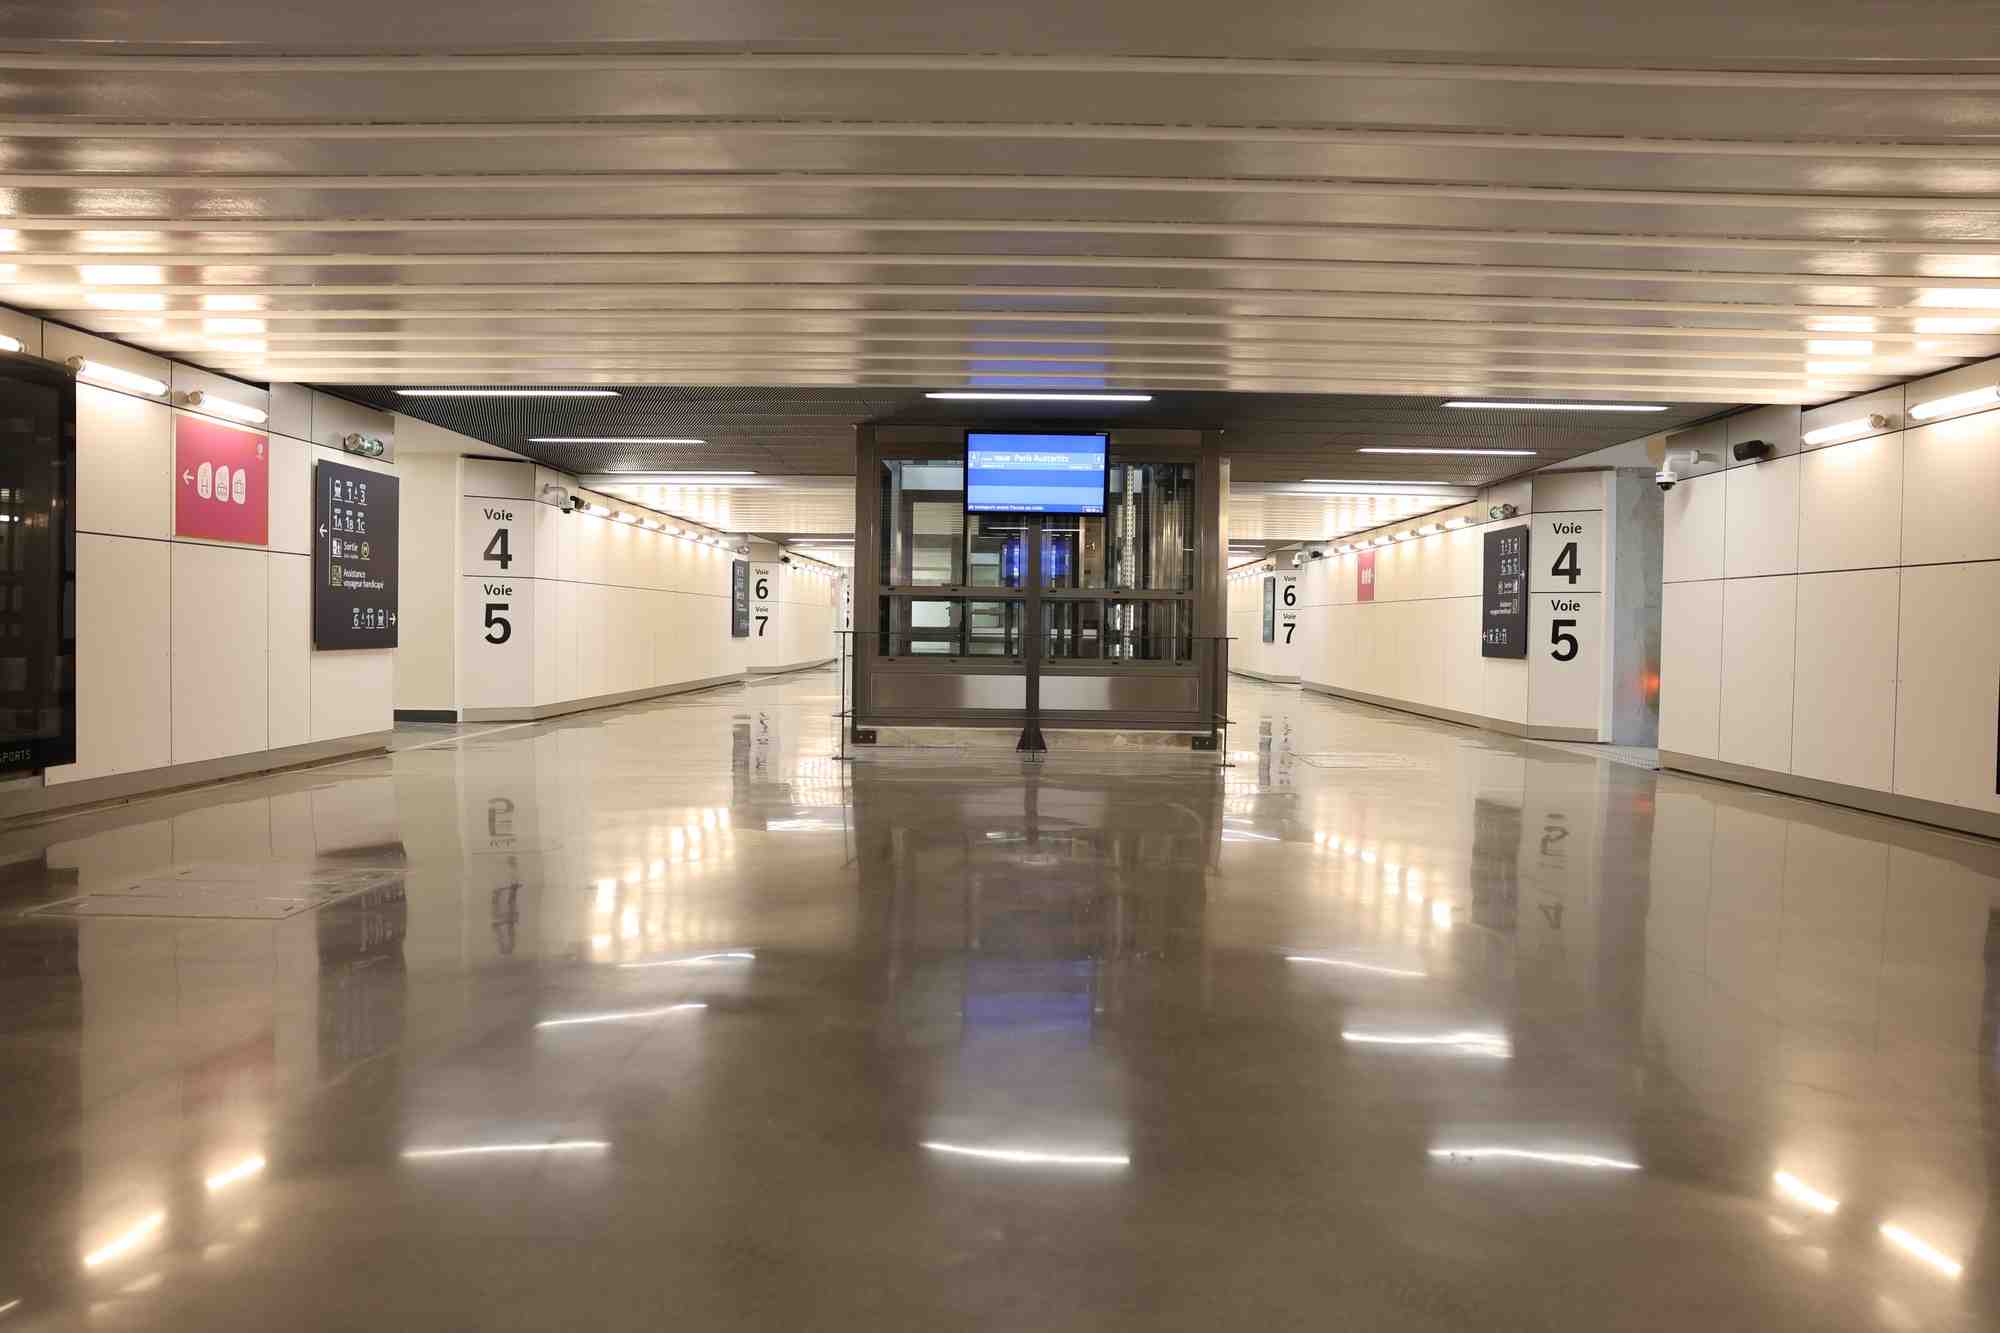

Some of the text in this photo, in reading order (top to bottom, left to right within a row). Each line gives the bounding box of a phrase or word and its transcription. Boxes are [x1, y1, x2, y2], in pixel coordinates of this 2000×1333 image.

[333, 515, 342, 529] 1A
[345, 516, 354, 530] 1B
[484, 508, 513, 521] Voie
[1553, 523, 1582, 534] Voie
[344, 541, 359, 551] Sortie
[483, 528, 512, 569] 4
[1551, 542, 1581, 584] 4
[484, 584, 513, 596] Voie
[755, 578, 768, 599] 6
[1284, 585, 1296, 606] 6
[1552, 600, 1580, 611] Voie
[485, 603, 511, 645] 5
[755, 616, 768, 636] 7
[1283, 623, 1296, 643] 7
[1551, 619, 1578, 662] 5
